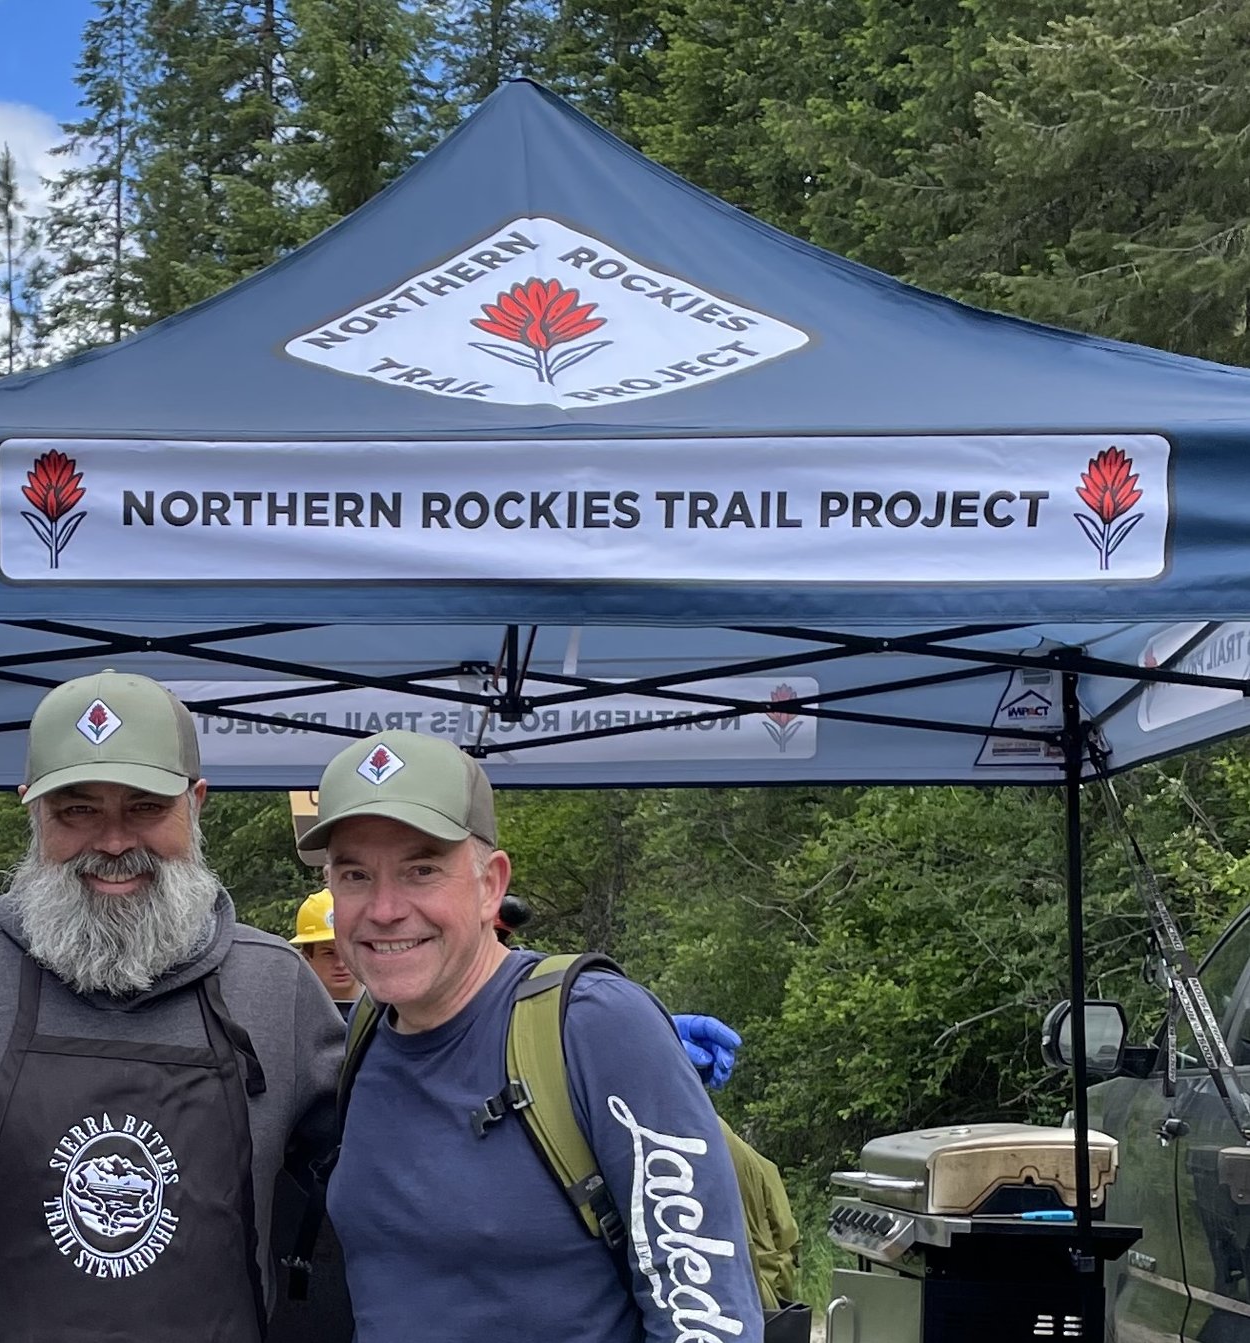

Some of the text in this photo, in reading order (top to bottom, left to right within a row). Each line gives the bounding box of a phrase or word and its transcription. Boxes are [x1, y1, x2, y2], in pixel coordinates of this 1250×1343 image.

[302, 230, 759, 350] NORTHERN ROCKIES
[366, 340, 759, 402] TRAIL PROJECT
[122, 489, 1050, 530] NORTHERN ROCKIES TRAIL PROJECT
[1190, 978, 1211, 1016] MOOSE
[49, 1112, 180, 1185] SIERRA BUTTES
[43, 1196, 180, 1279] TRAIL STEWARDSHIP
